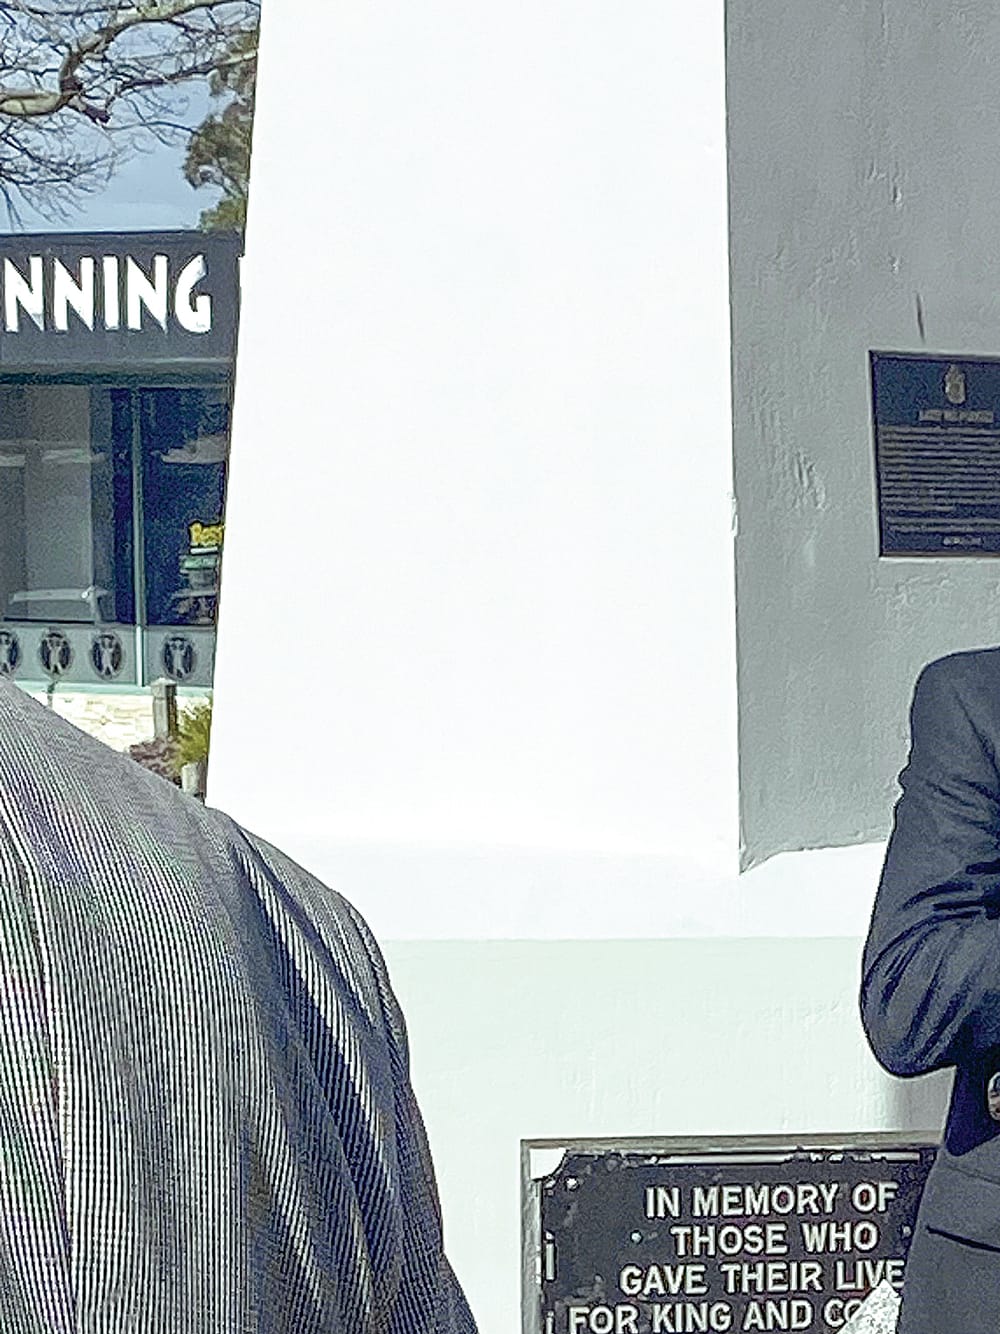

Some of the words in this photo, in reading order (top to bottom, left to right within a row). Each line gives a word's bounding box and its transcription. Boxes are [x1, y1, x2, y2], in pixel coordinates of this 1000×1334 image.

[3, 254, 212, 334] NNING
[645, 1186, 680, 1219] IN
[692, 1183, 837, 1217] MEMORY
[853, 1182, 899, 1212] OF
[670, 1224, 788, 1255] THOSE
[801, 1221, 879, 1252] WHO
[619, 1265, 708, 1297] GAVE
[720, 1262, 823, 1293] THEIR
[651, 1302, 731, 1333] KING
[743, 1299, 812, 1331] AND
